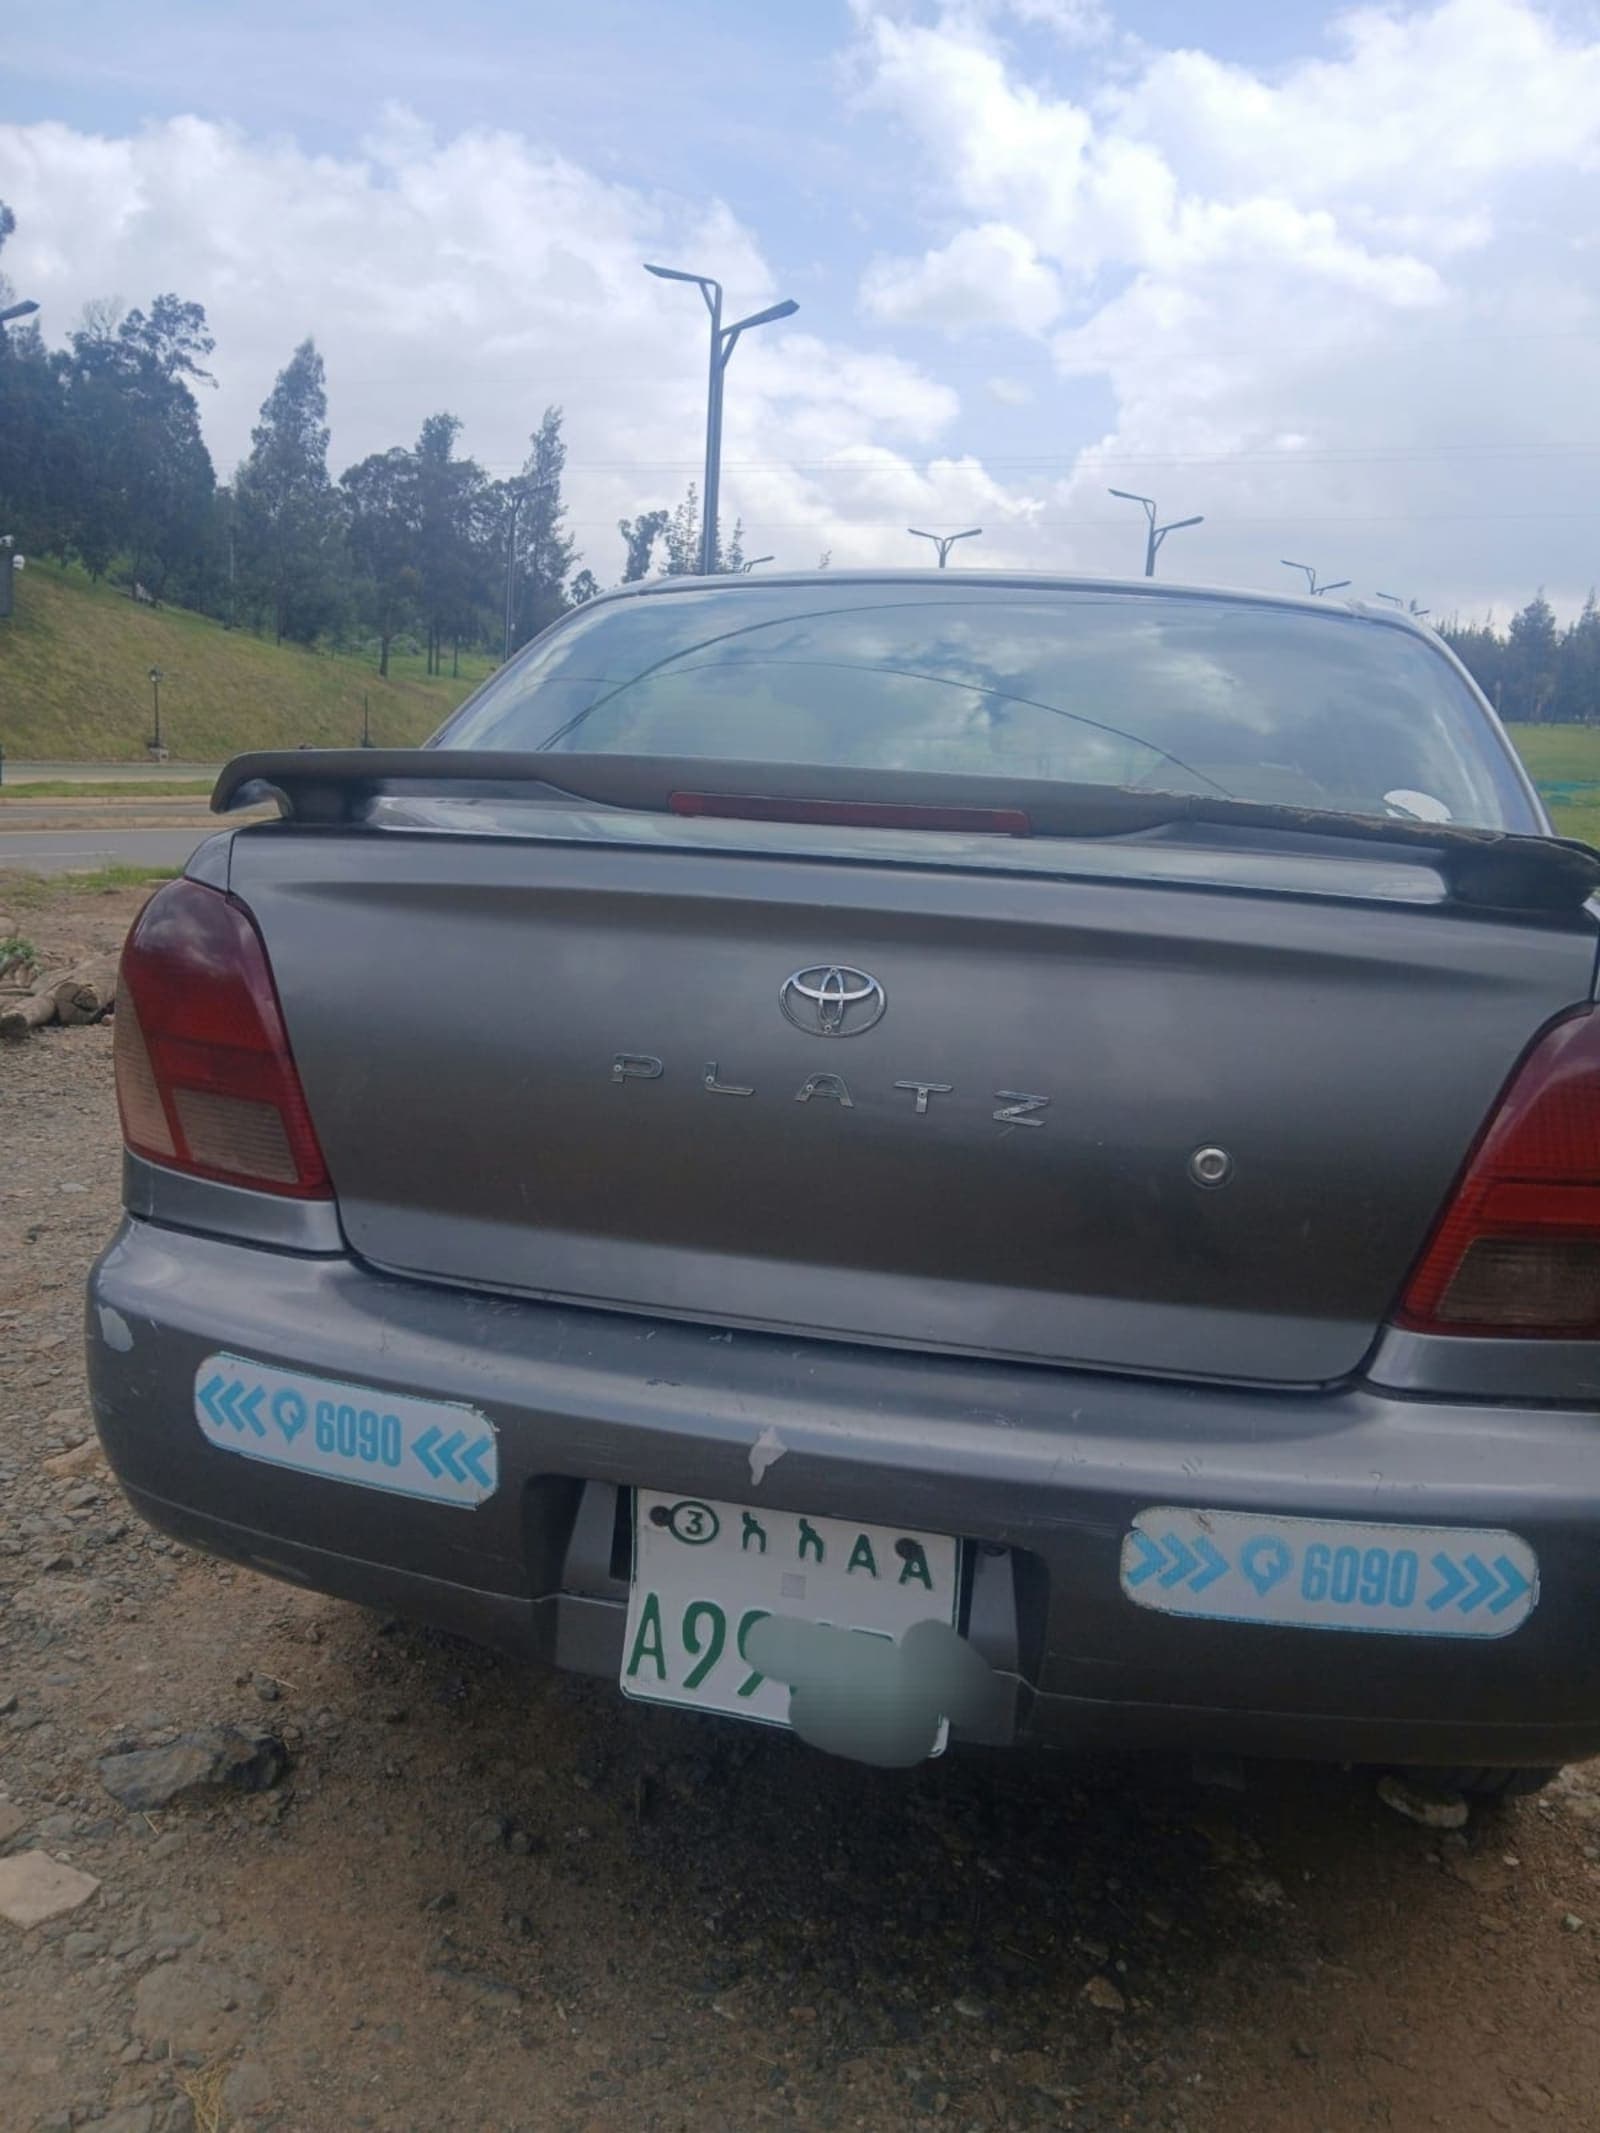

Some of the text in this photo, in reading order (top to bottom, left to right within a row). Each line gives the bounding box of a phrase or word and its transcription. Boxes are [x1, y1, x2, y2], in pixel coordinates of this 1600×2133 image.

[608, 1053, 1050, 1128] PLATZ
[314, 1400, 401, 1468] 6090
[1301, 1543, 1420, 1608] 6090
